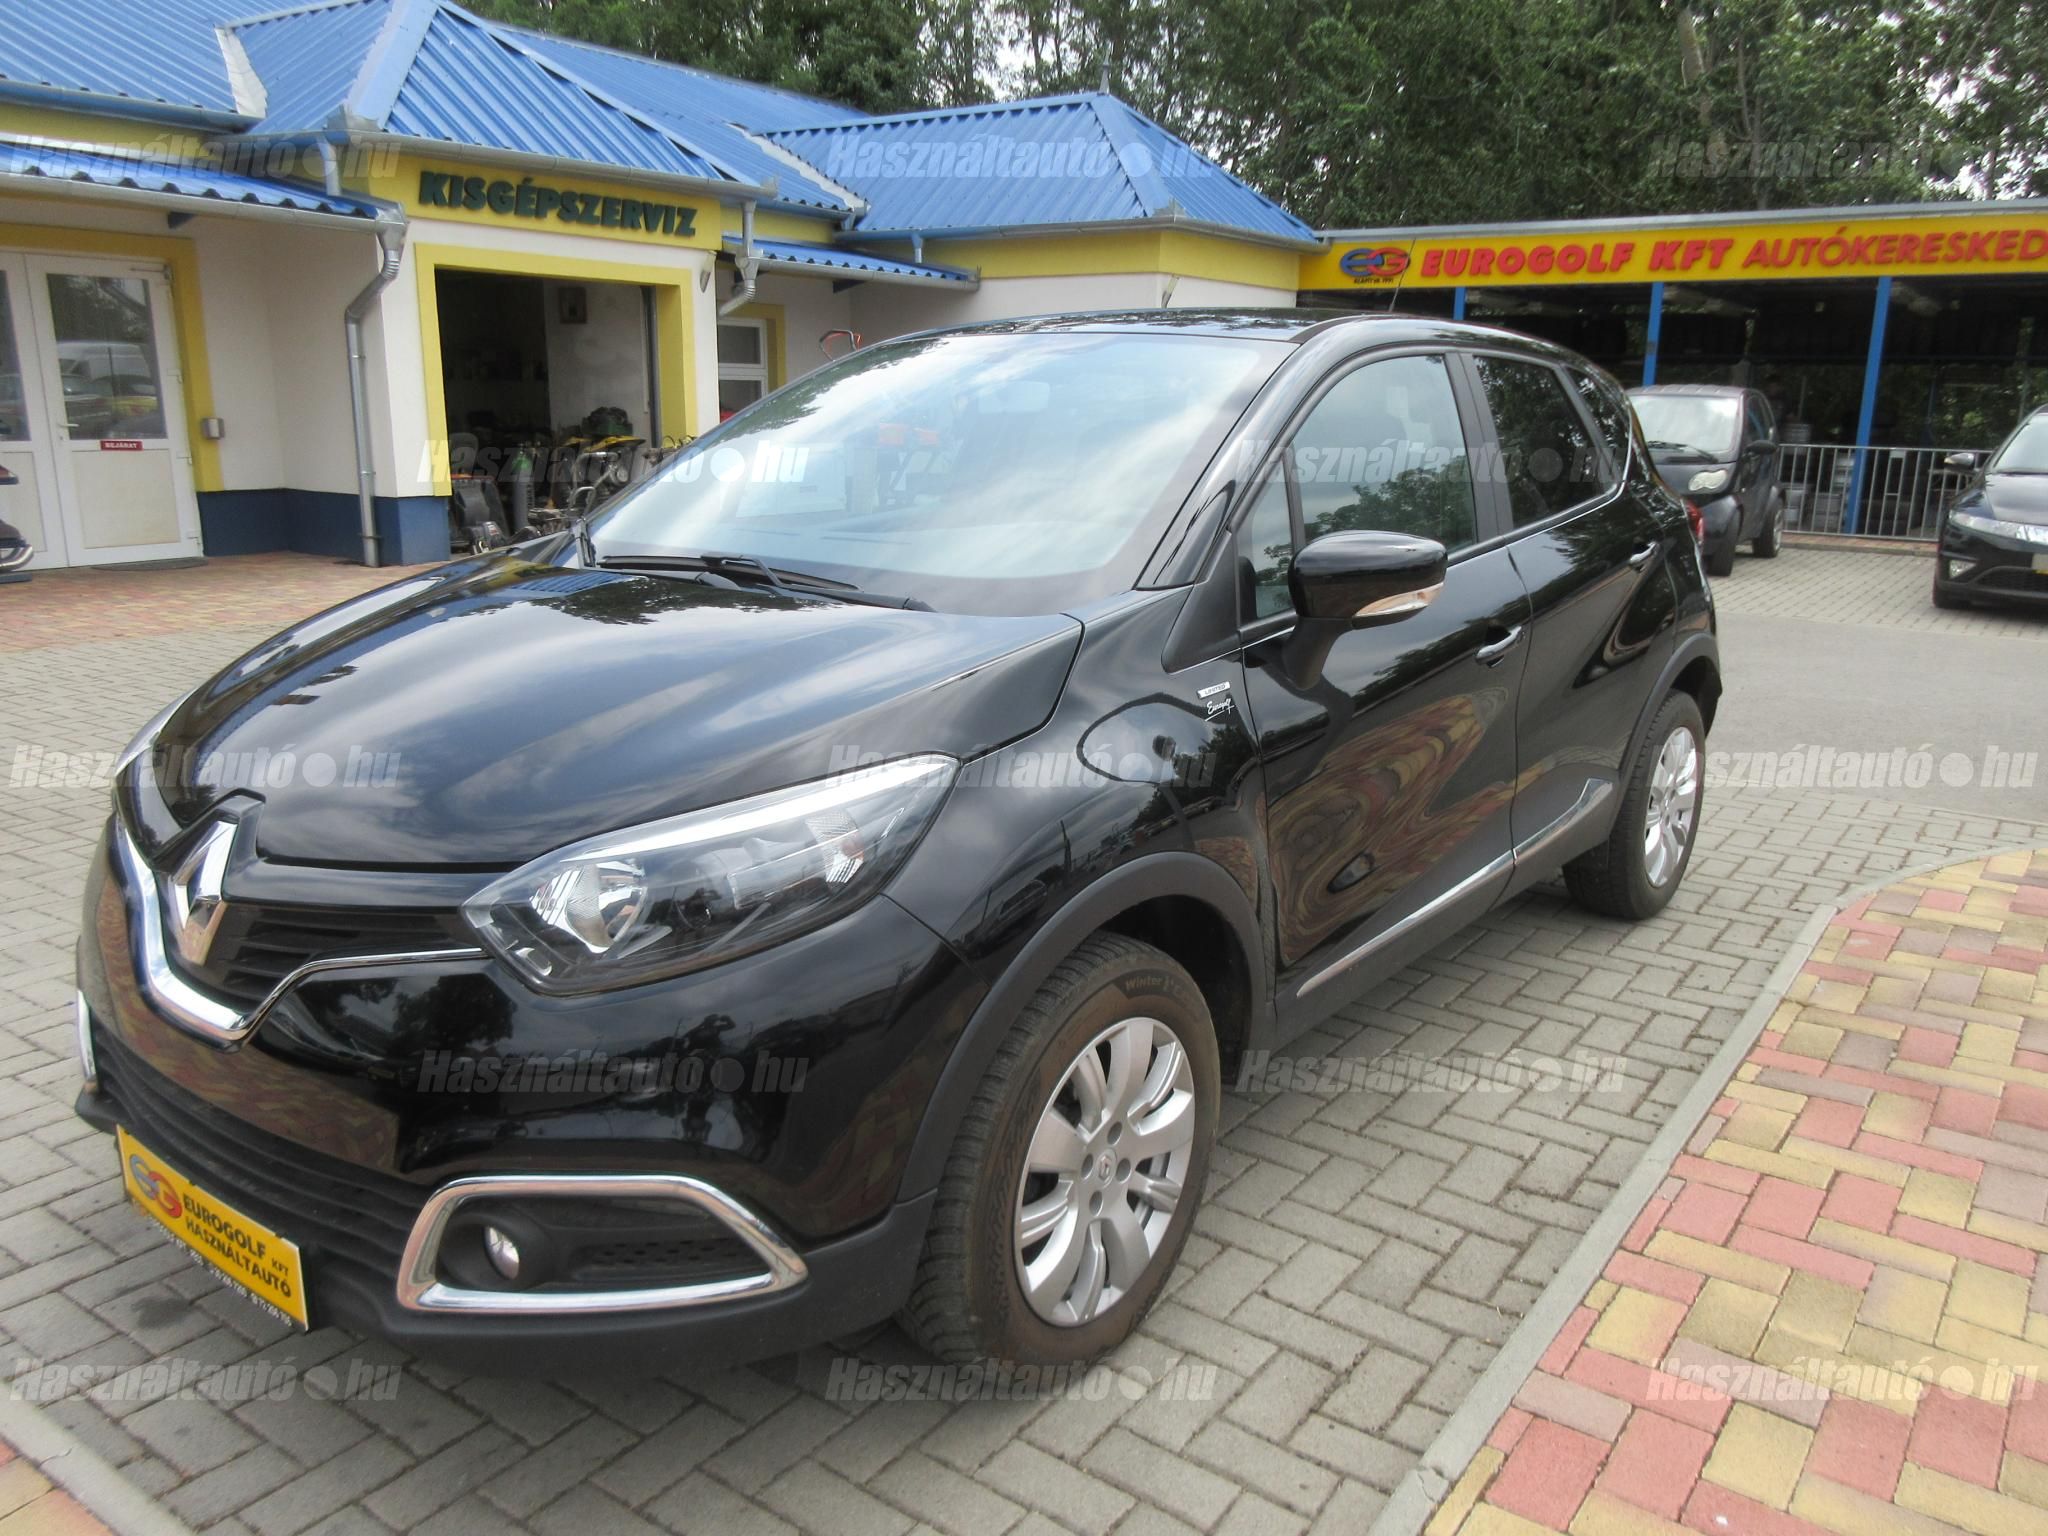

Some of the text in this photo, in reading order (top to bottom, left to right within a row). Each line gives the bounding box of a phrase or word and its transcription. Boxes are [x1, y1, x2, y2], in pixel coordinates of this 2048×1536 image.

[419, 170, 697, 238] KISGÉPSZERVIZ
[1420, 226, 2048, 277] EUROGOLF KFT AUTÓKERESKED
[183, 1194, 290, 1275] EUROGOLF KFT
[185, 1216, 292, 1298] HASZNÁLTAUTÓ
